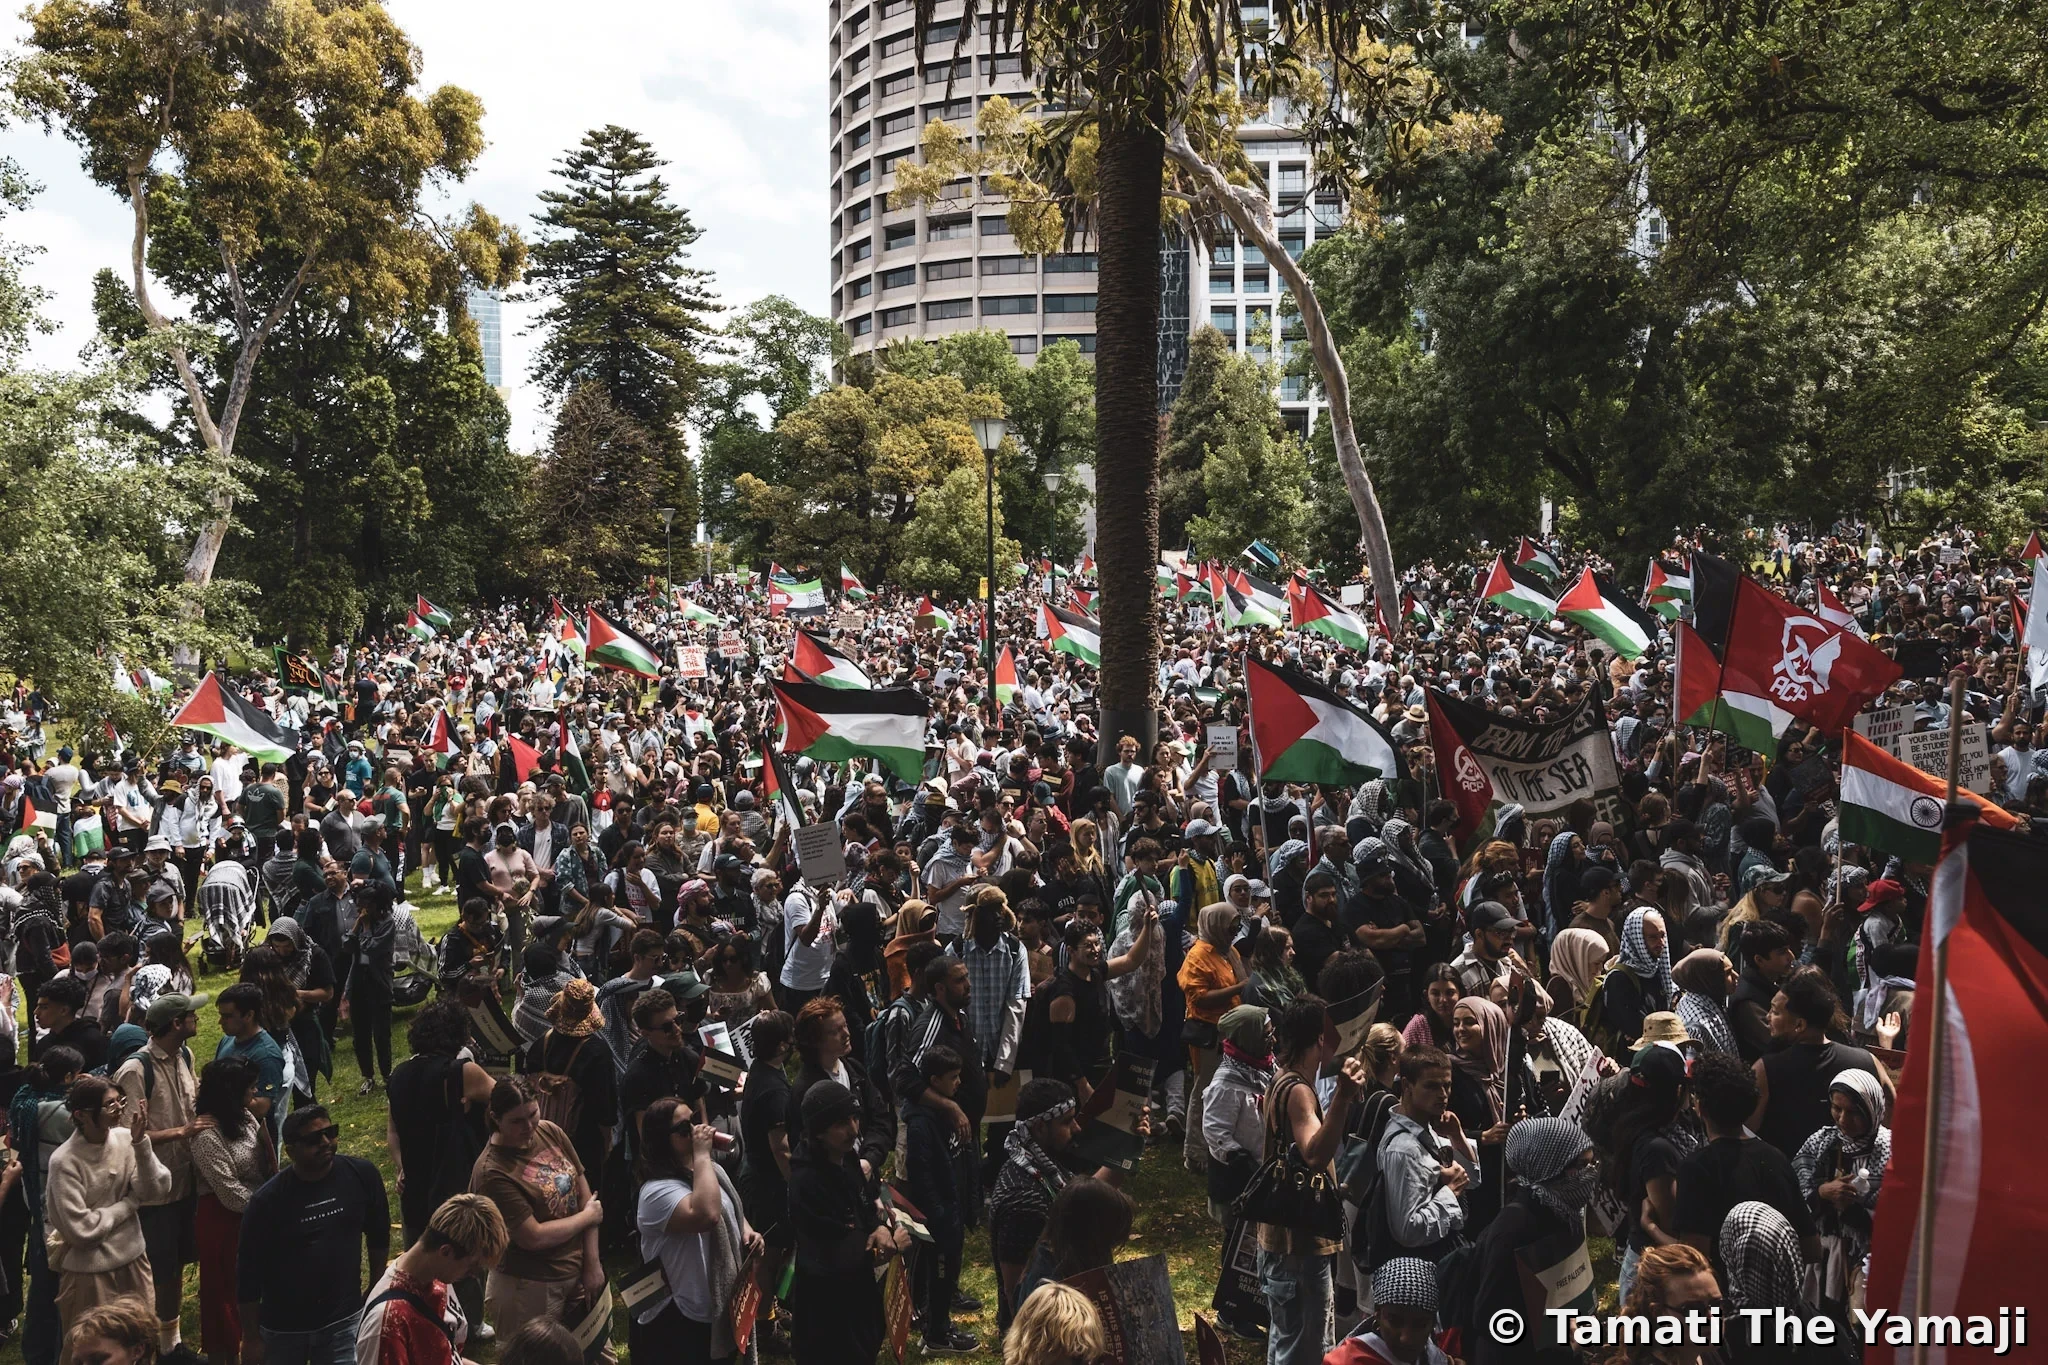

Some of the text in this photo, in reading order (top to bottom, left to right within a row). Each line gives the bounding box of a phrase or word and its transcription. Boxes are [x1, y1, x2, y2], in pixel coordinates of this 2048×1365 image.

[722, 632, 733, 640] NO
[684, 660, 700, 668] THE
[1769, 676, 1808, 702] ACP
[1868, 721, 1903, 737] VICTIMS
[1908, 735, 1928, 745] YOUR
[1911, 745, 1921, 753] BE
[1962, 736, 1981, 745] YOUR
[1970, 751, 1984, 760] YOU
[1973, 764, 1989, 774] HOW
[1513, 768, 1556, 801] THE
[1548, 752, 1594, 795] SEA
[1462, 780, 1485, 792] ACP
[1556, 1262, 1586, 1290] FREE PALESTINE
[1098, 1290, 1124, 1363] IS THIS SELF
